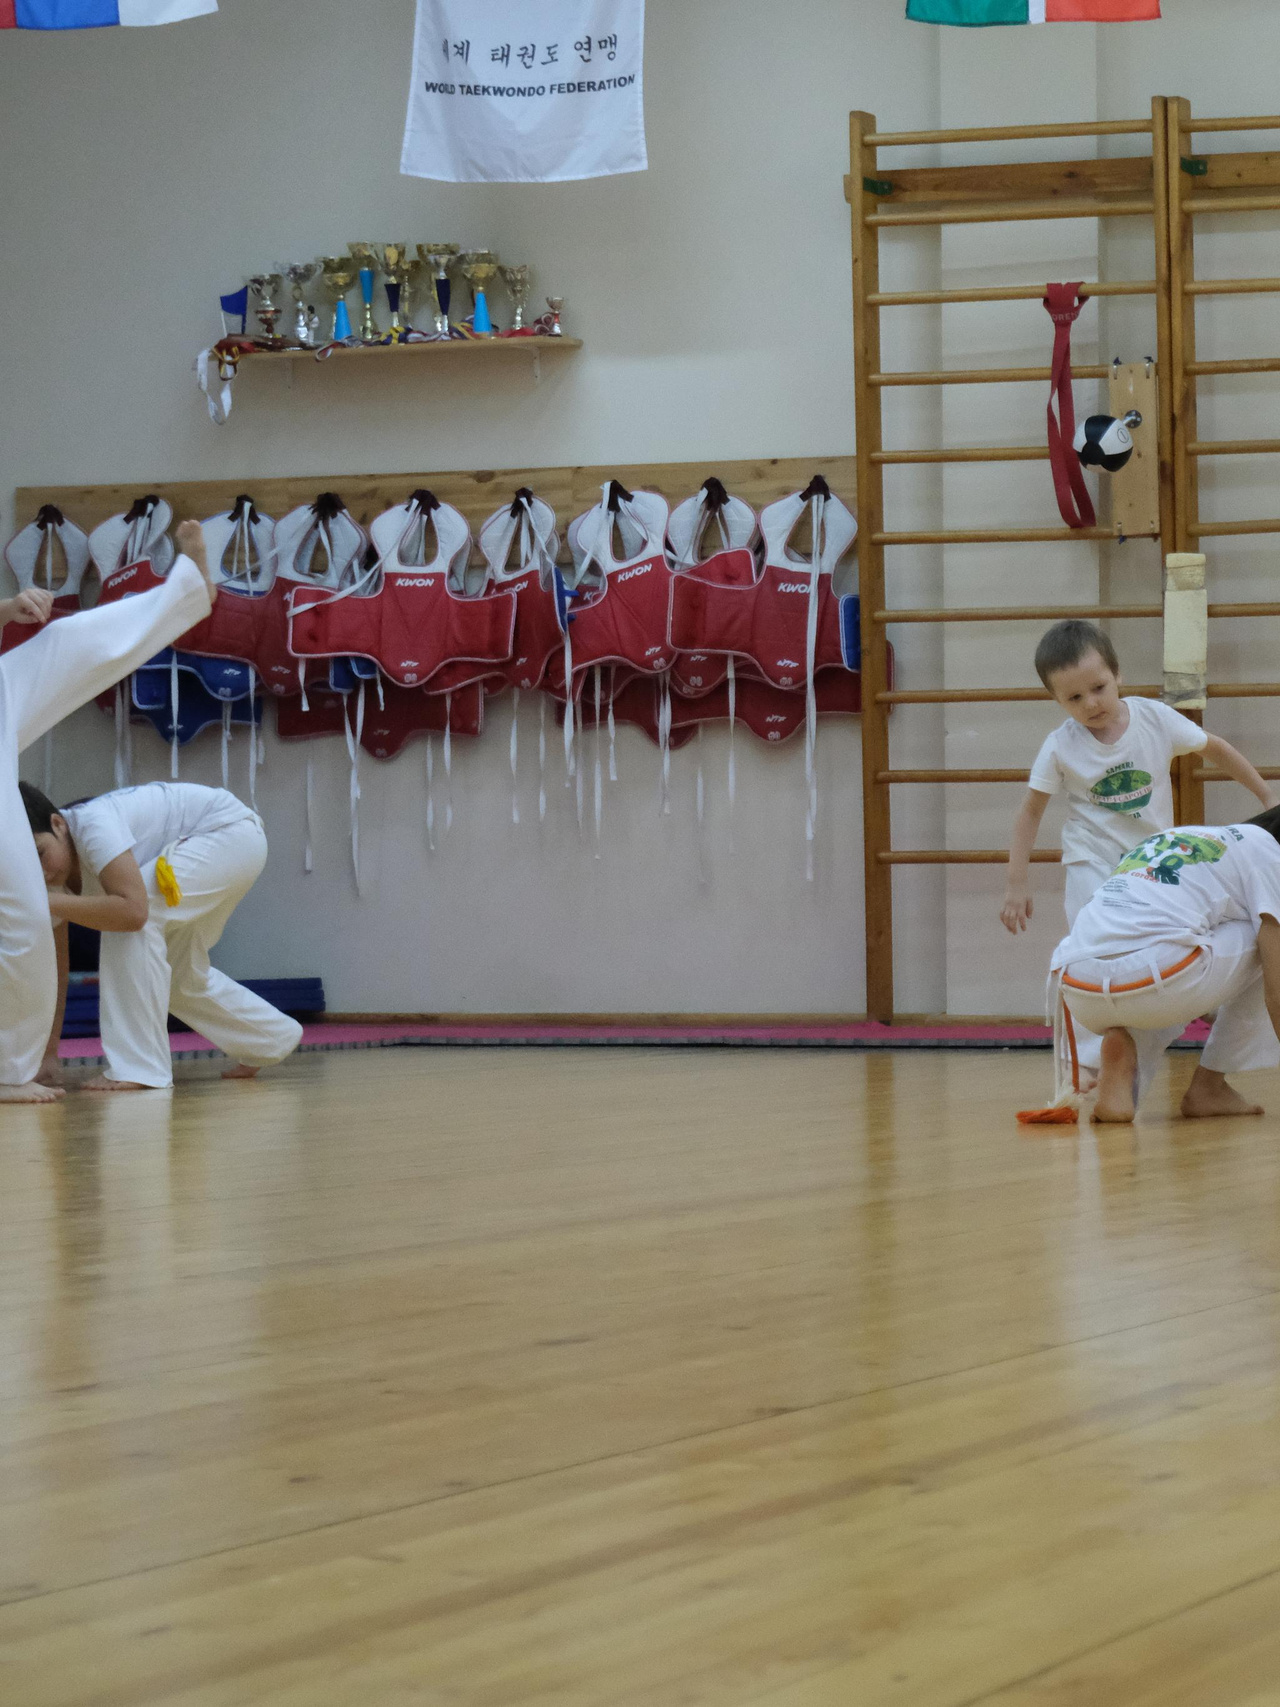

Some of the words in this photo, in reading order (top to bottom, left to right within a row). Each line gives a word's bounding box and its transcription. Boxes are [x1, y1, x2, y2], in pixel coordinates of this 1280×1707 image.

[458, 84, 546, 97] TAEKWONDO
[549, 74, 635, 95] FEDERATION
[395, 577, 435, 588] KWON
[617, 563, 653, 583] KWON
